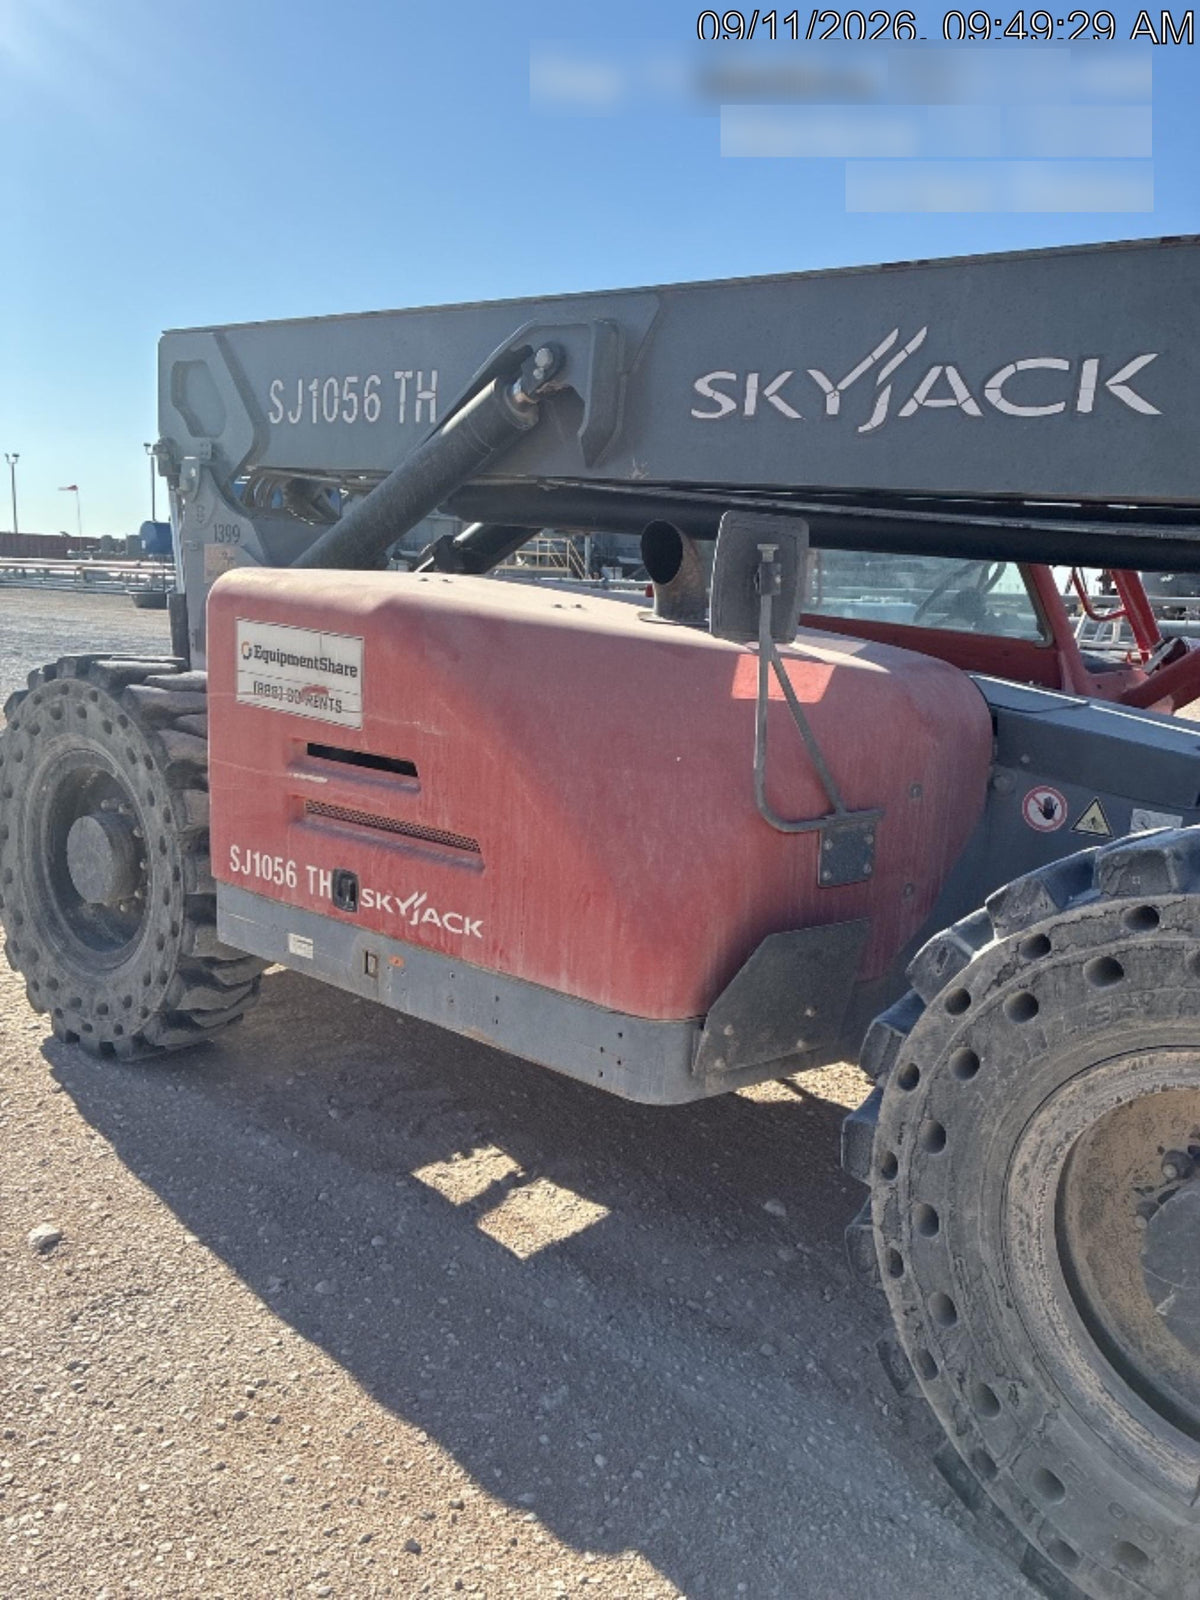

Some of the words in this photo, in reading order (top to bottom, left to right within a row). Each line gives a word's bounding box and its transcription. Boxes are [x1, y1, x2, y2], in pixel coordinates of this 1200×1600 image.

[268, 374, 381, 424] SJ1056
[394, 370, 438, 424] TH
[691, 326, 1163, 433] SKYJACK
[253, 644, 358, 678] EquipmentShare
[229, 844, 297, 888] SJ1056
[306, 865, 333, 899] TH
[360, 888, 484, 938] SKYJACK
